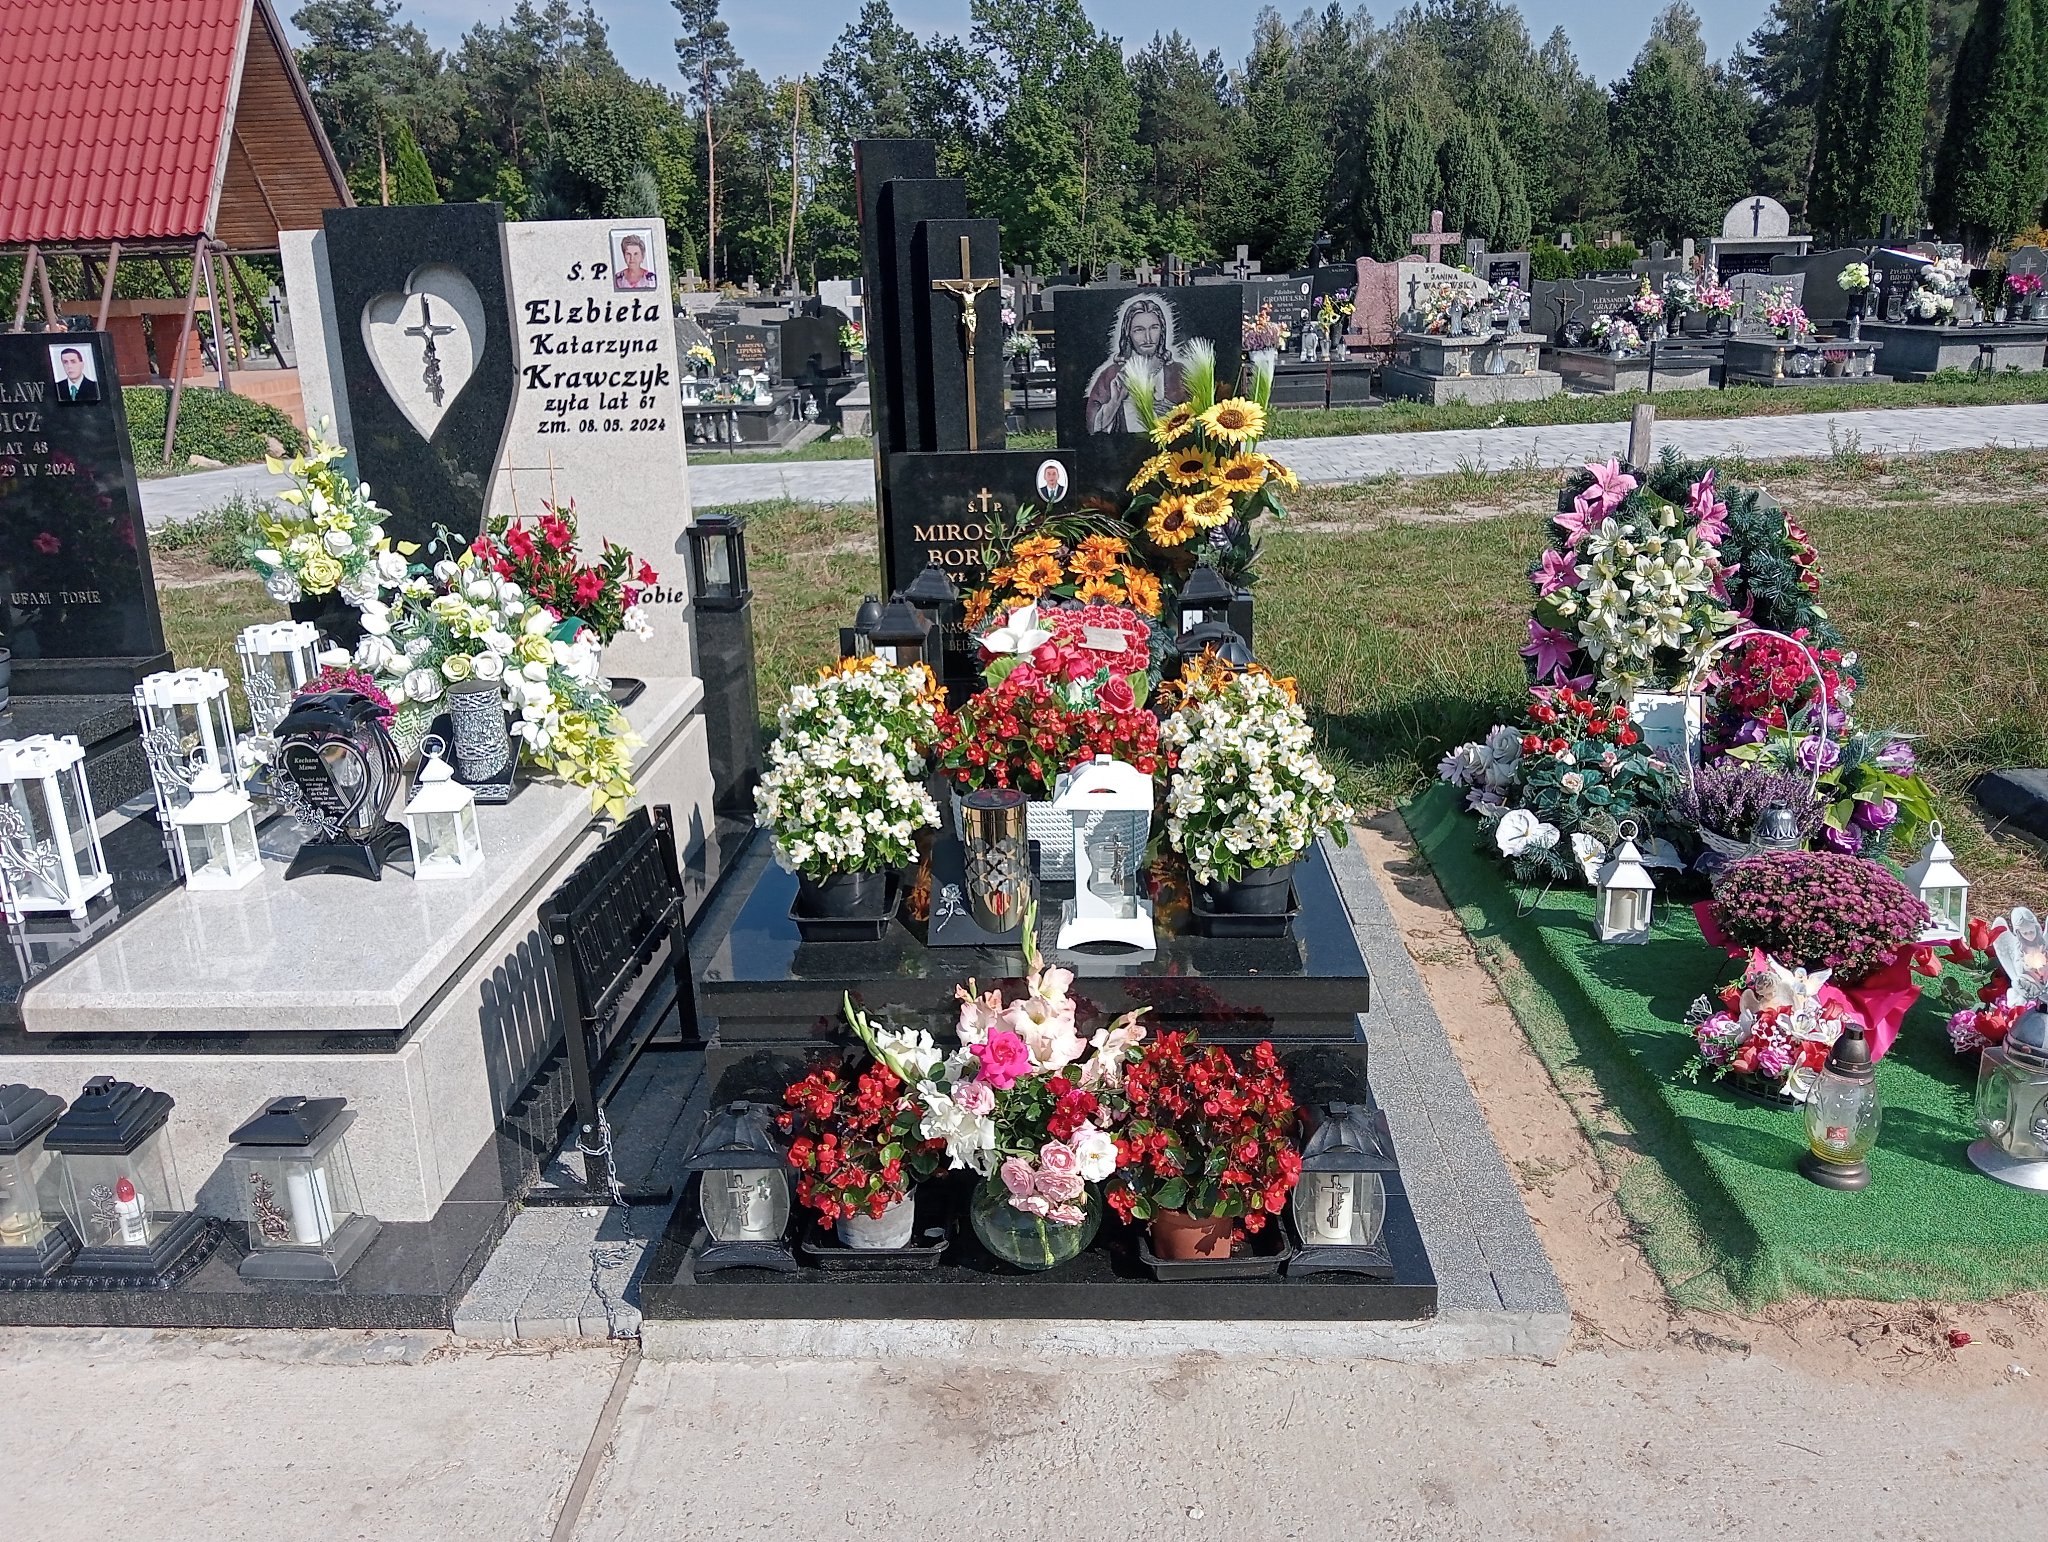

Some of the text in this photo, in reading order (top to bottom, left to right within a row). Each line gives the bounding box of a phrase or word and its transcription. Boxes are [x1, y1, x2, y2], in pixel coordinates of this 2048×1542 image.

[567, 261, 608, 281] Ś. P.
[1423, 281, 1477, 289] WASWSKA
[1263, 294, 1307, 302] GROMULSKI
[525, 297, 660, 324] Elzbieta
[530, 333, 658, 359] Katarzyna
[523, 363, 669, 394] Krawczyk
[599, 391, 629, 410] lat
[639, 395, 656, 409] 67
[0, 411, 41, 433] ICZ
[537, 418, 666, 433] zm. 08. 05. 2024
[32, 441, 49, 454] 48
[1, 462, 76, 477] 29 IV 2024
[967, 500, 1003, 513] Ś. P.
[10, 590, 101, 605] UFAM TOBIE
